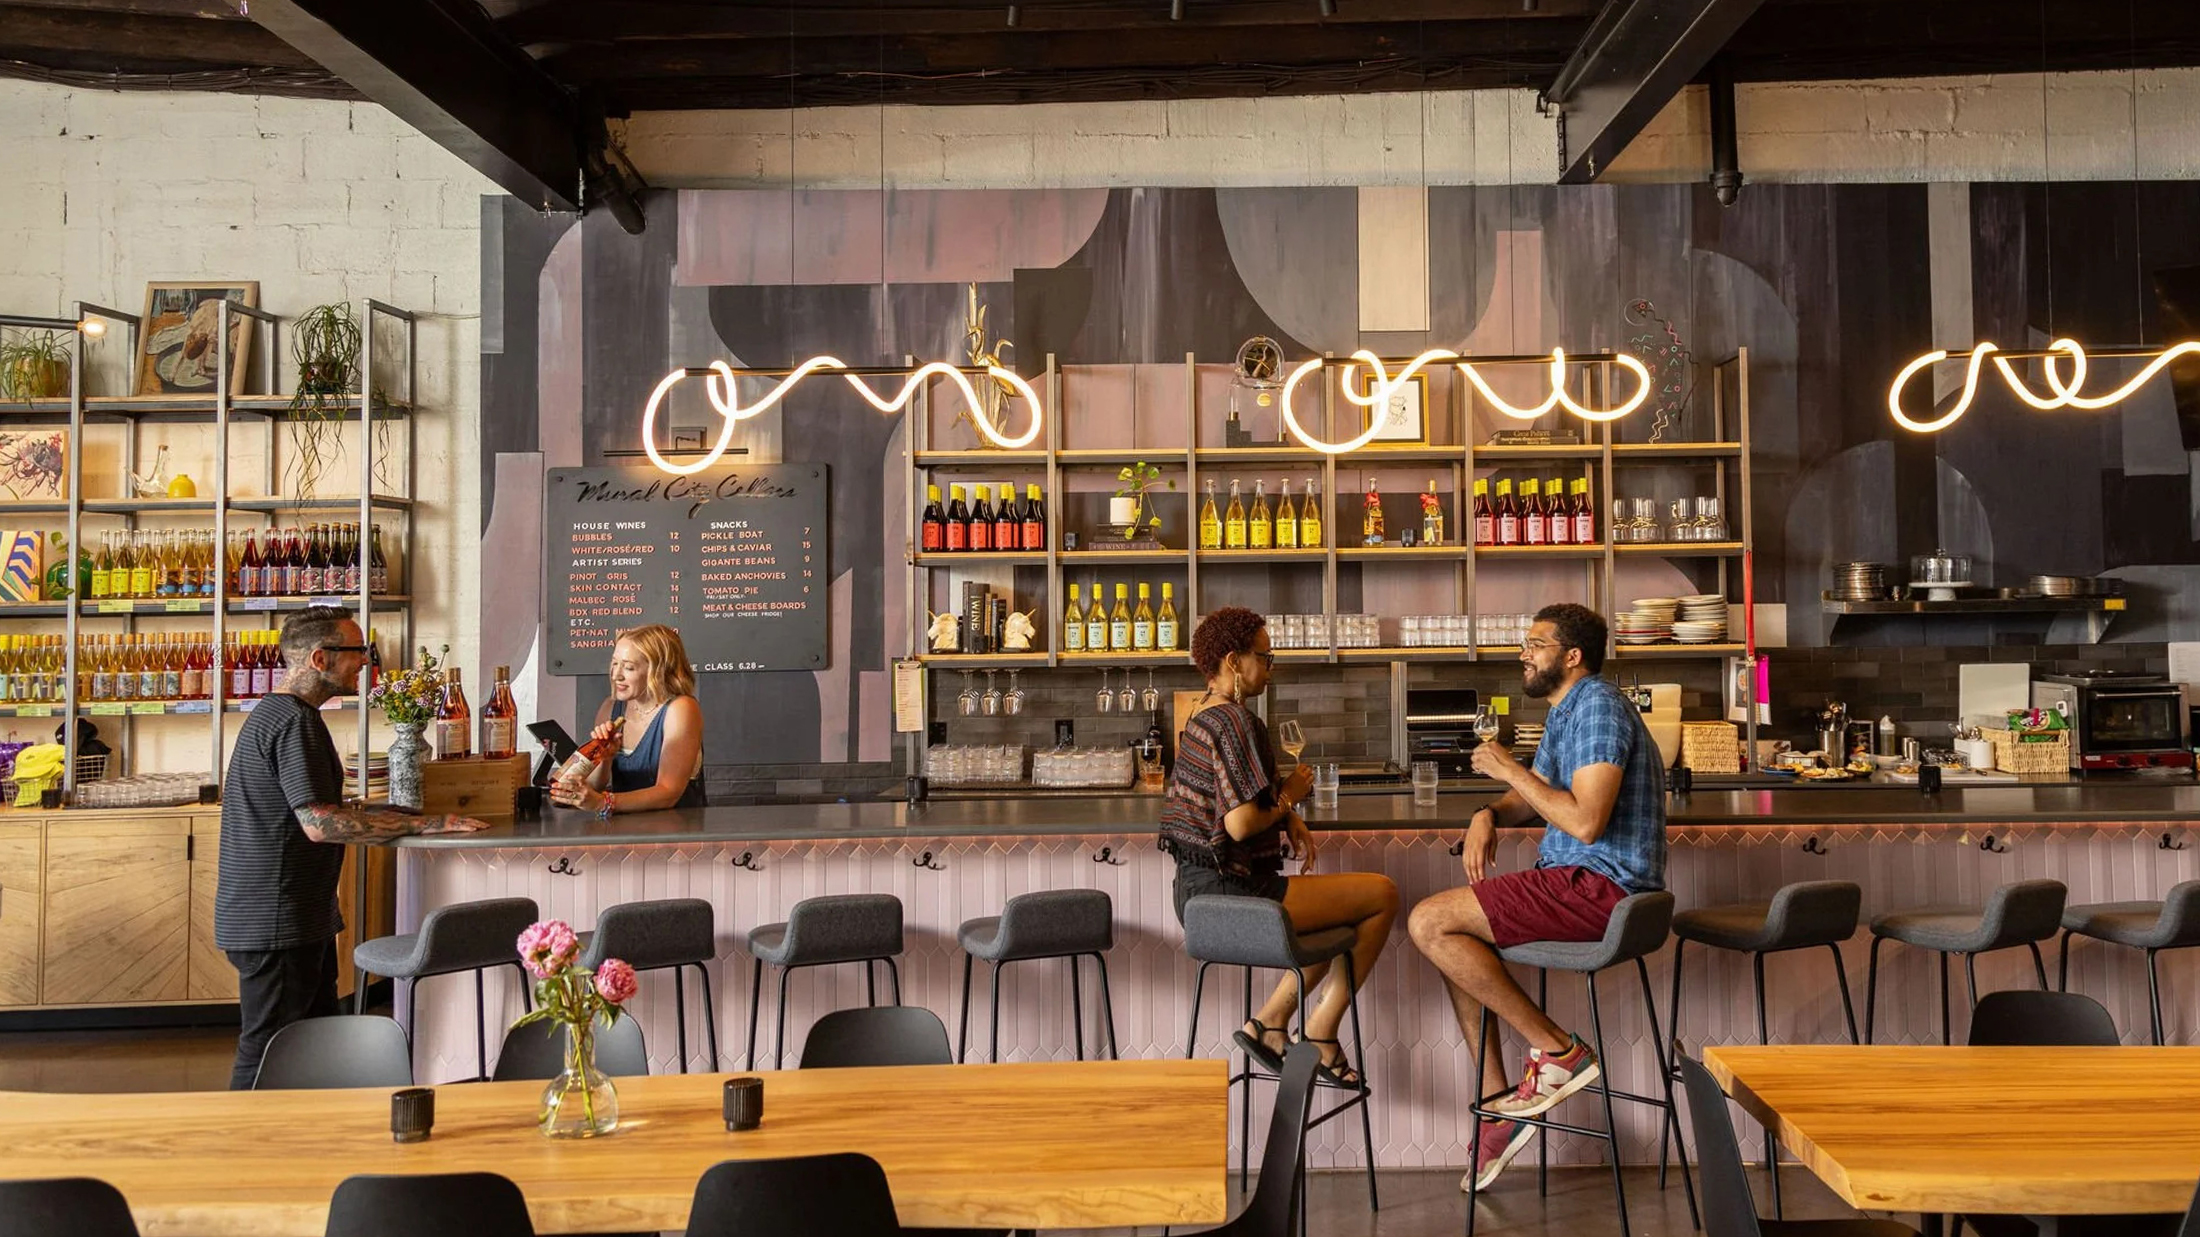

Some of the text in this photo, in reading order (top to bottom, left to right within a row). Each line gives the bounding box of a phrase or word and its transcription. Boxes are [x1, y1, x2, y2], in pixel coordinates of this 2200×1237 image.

[576, 473, 798, 520] Mural City Cellars
[573, 521, 646, 530] HOUSE WINES
[710, 520, 748, 530] SNACKS
[572, 531, 680, 542] BUBBLES 12
[701, 527, 811, 540] PICKLE BOAT 7
[572, 544, 680, 555] WHITE/ROSÉ/RED 10
[701, 545, 727, 553] CHIPS
[737, 543, 772, 552] CAVIAR
[802, 541, 811, 549] 15
[572, 558, 642, 567] ARTIST SERIES
[701, 555, 810, 567] GIGANTE BEANS 9
[569, 573, 597, 581] PINOT
[670, 571, 679, 579] 12
[701, 569, 812, 581] BAKED ANCHOVIES 14
[570, 584, 592, 593] SKIN
[702, 586, 739, 595] TOMATO
[569, 596, 606, 604] MALBEC
[612, 592, 636, 603] ROSÉ
[702, 604, 726, 612] MEAT
[735, 602, 768, 610] CHEESE
[770, 601, 806, 610] BOARDS
[569, 609, 588, 617] BOX
[592, 608, 611, 616] RED
[613, 607, 643, 615] BLEND
[971, 598, 981, 631] WINE
[570, 618, 595, 626] ETC.
[570, 640, 615, 649] SANGRIA
[705, 663, 734, 671] CLASS
